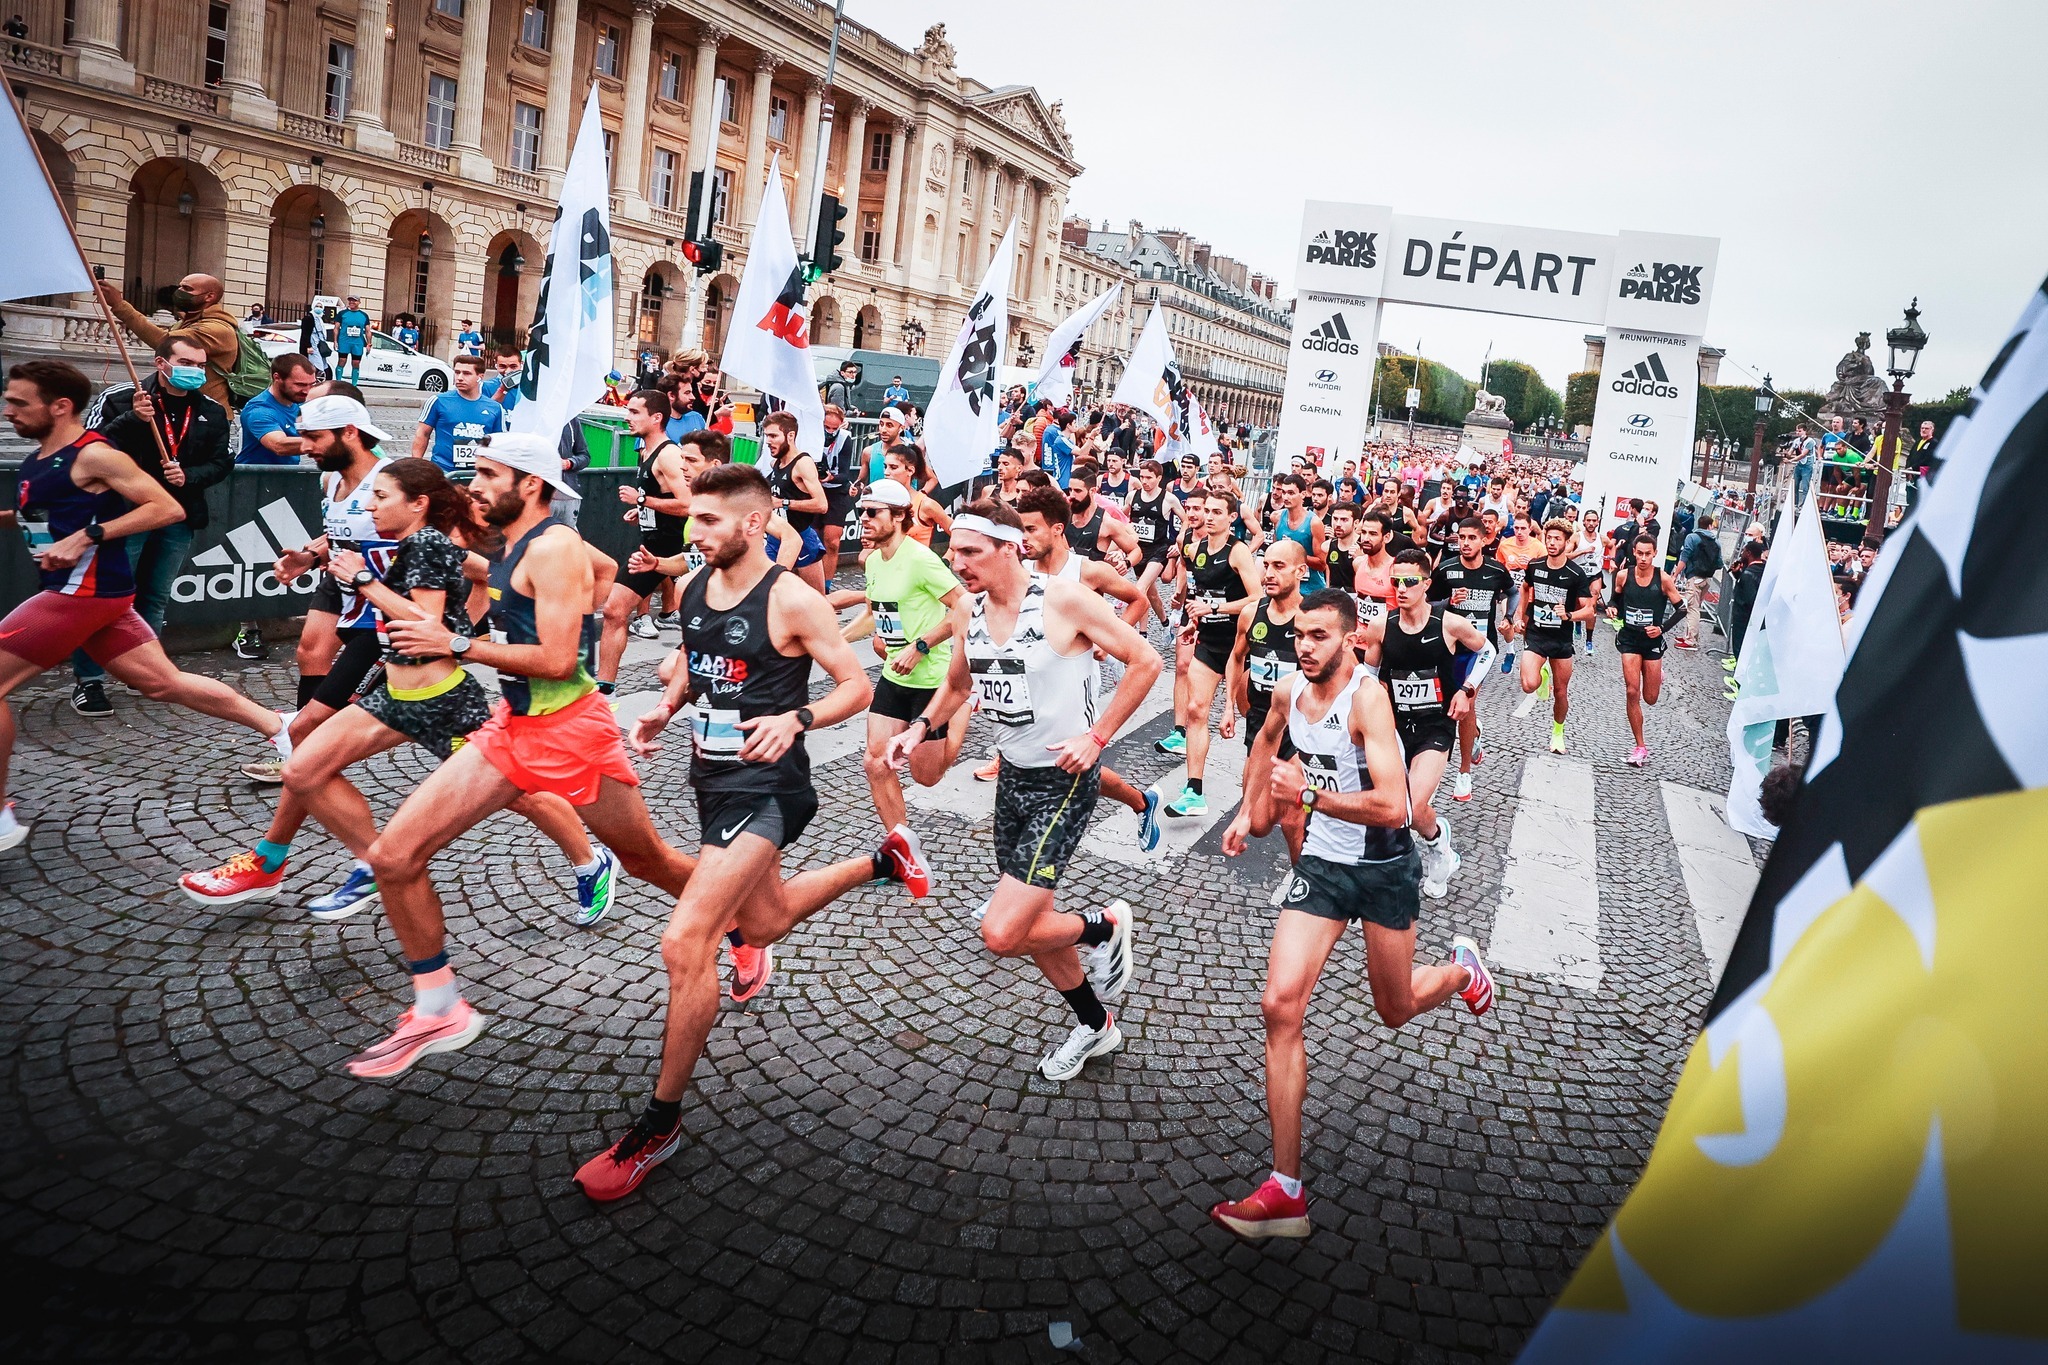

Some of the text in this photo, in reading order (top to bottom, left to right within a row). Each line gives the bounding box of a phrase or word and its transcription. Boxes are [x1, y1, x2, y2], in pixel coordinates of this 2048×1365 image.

[1334, 230, 1378, 251] 10K
[1306, 245, 1377, 268] PARIS
[1403, 231, 1596, 296] DÉPART
[1652, 262, 1703, 286] 10K
[1619, 278, 1701, 305] PARIS
[1308, 295, 1366, 307] #RUNWITHPARIS
[1302, 336, 1359, 355] adidas
[1619, 333, 1687, 346] #RUNWITHPARIS
[1308, 382, 1341, 391] HYUNDAI
[1612, 379, 1678, 398] adidas
[1300, 404, 1342, 416] GARMIN
[1620, 428, 1657, 437] HYUNDAI
[1609, 452, 1658, 464] GARMIN
[170, 563, 321, 603] adida
[1359, 602, 1379, 616] 2595
[1540, 610, 1553, 622] 24
[1635, 613, 1644, 621] 19
[879, 614, 893, 634] 20
[1263, 662, 1279, 681] 21
[979, 679, 1014, 704] 2792
[1397, 684, 1429, 698] 2977
[1323, 723, 1342, 731] adidas
